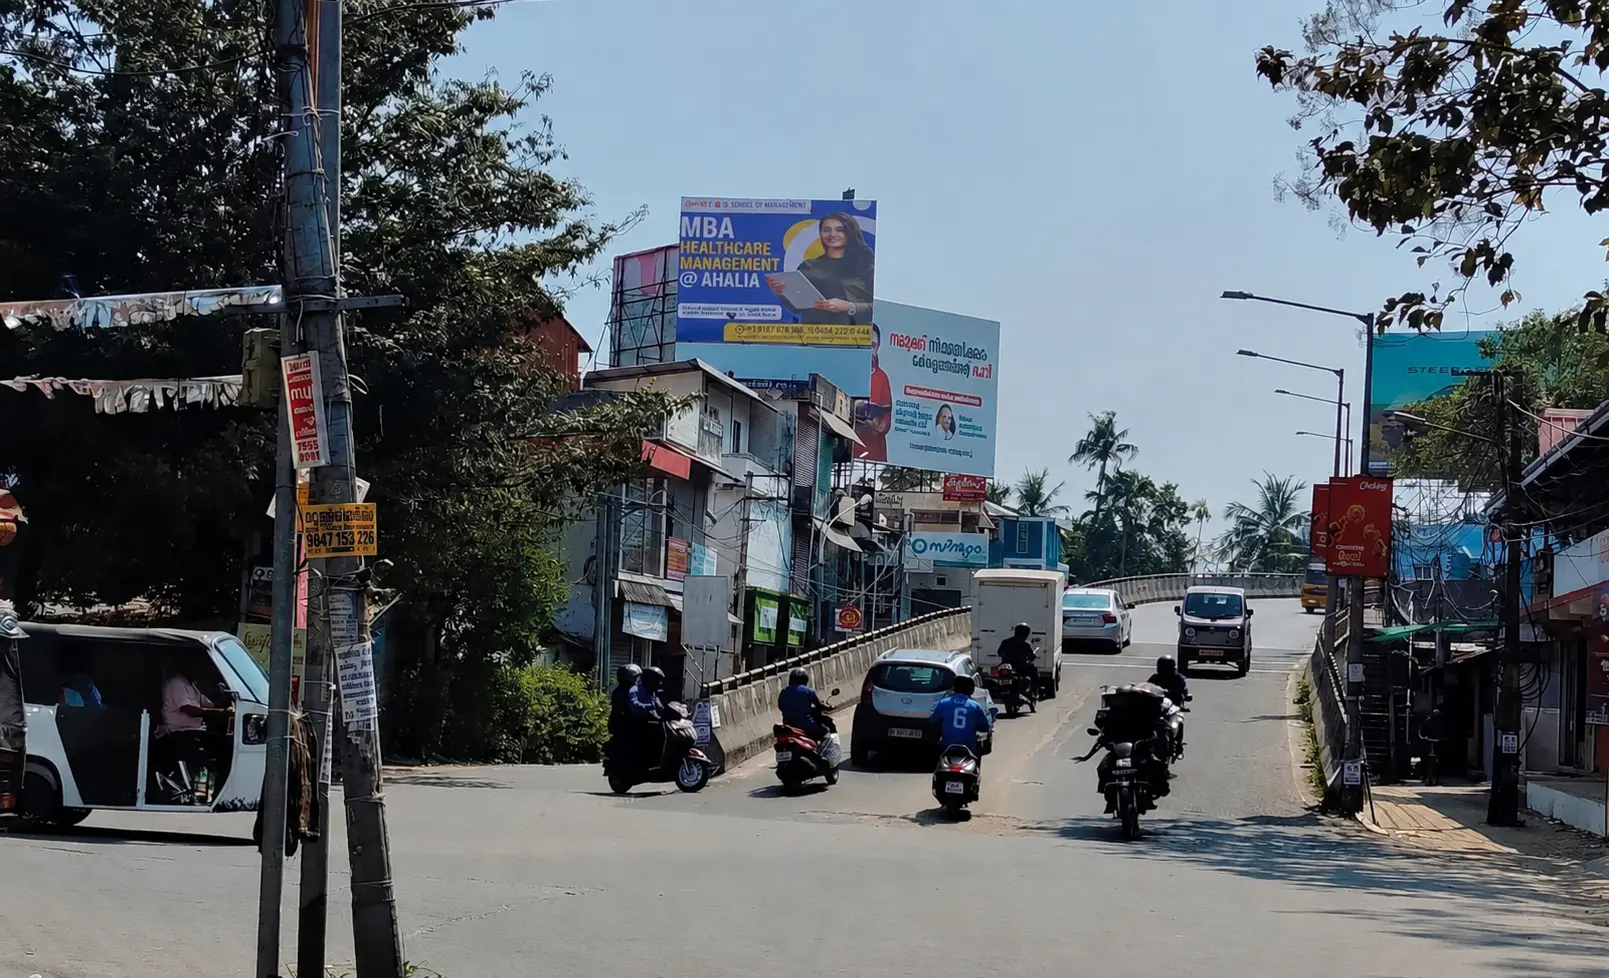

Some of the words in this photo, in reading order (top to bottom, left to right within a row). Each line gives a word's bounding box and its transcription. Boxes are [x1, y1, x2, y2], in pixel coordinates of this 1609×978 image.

[681, 216, 735, 239] MBA
[680, 241, 771, 256] HEALTHCARE
[680, 257, 780, 272] MANAGEMENT
[679, 271, 698, 288] @
[701, 273, 760, 288] AHALIA
[306, 532, 333, 547] 9847
[335, 531, 355, 546] 153
[357, 530, 374, 545] 226
[953, 707, 967, 729] 6
